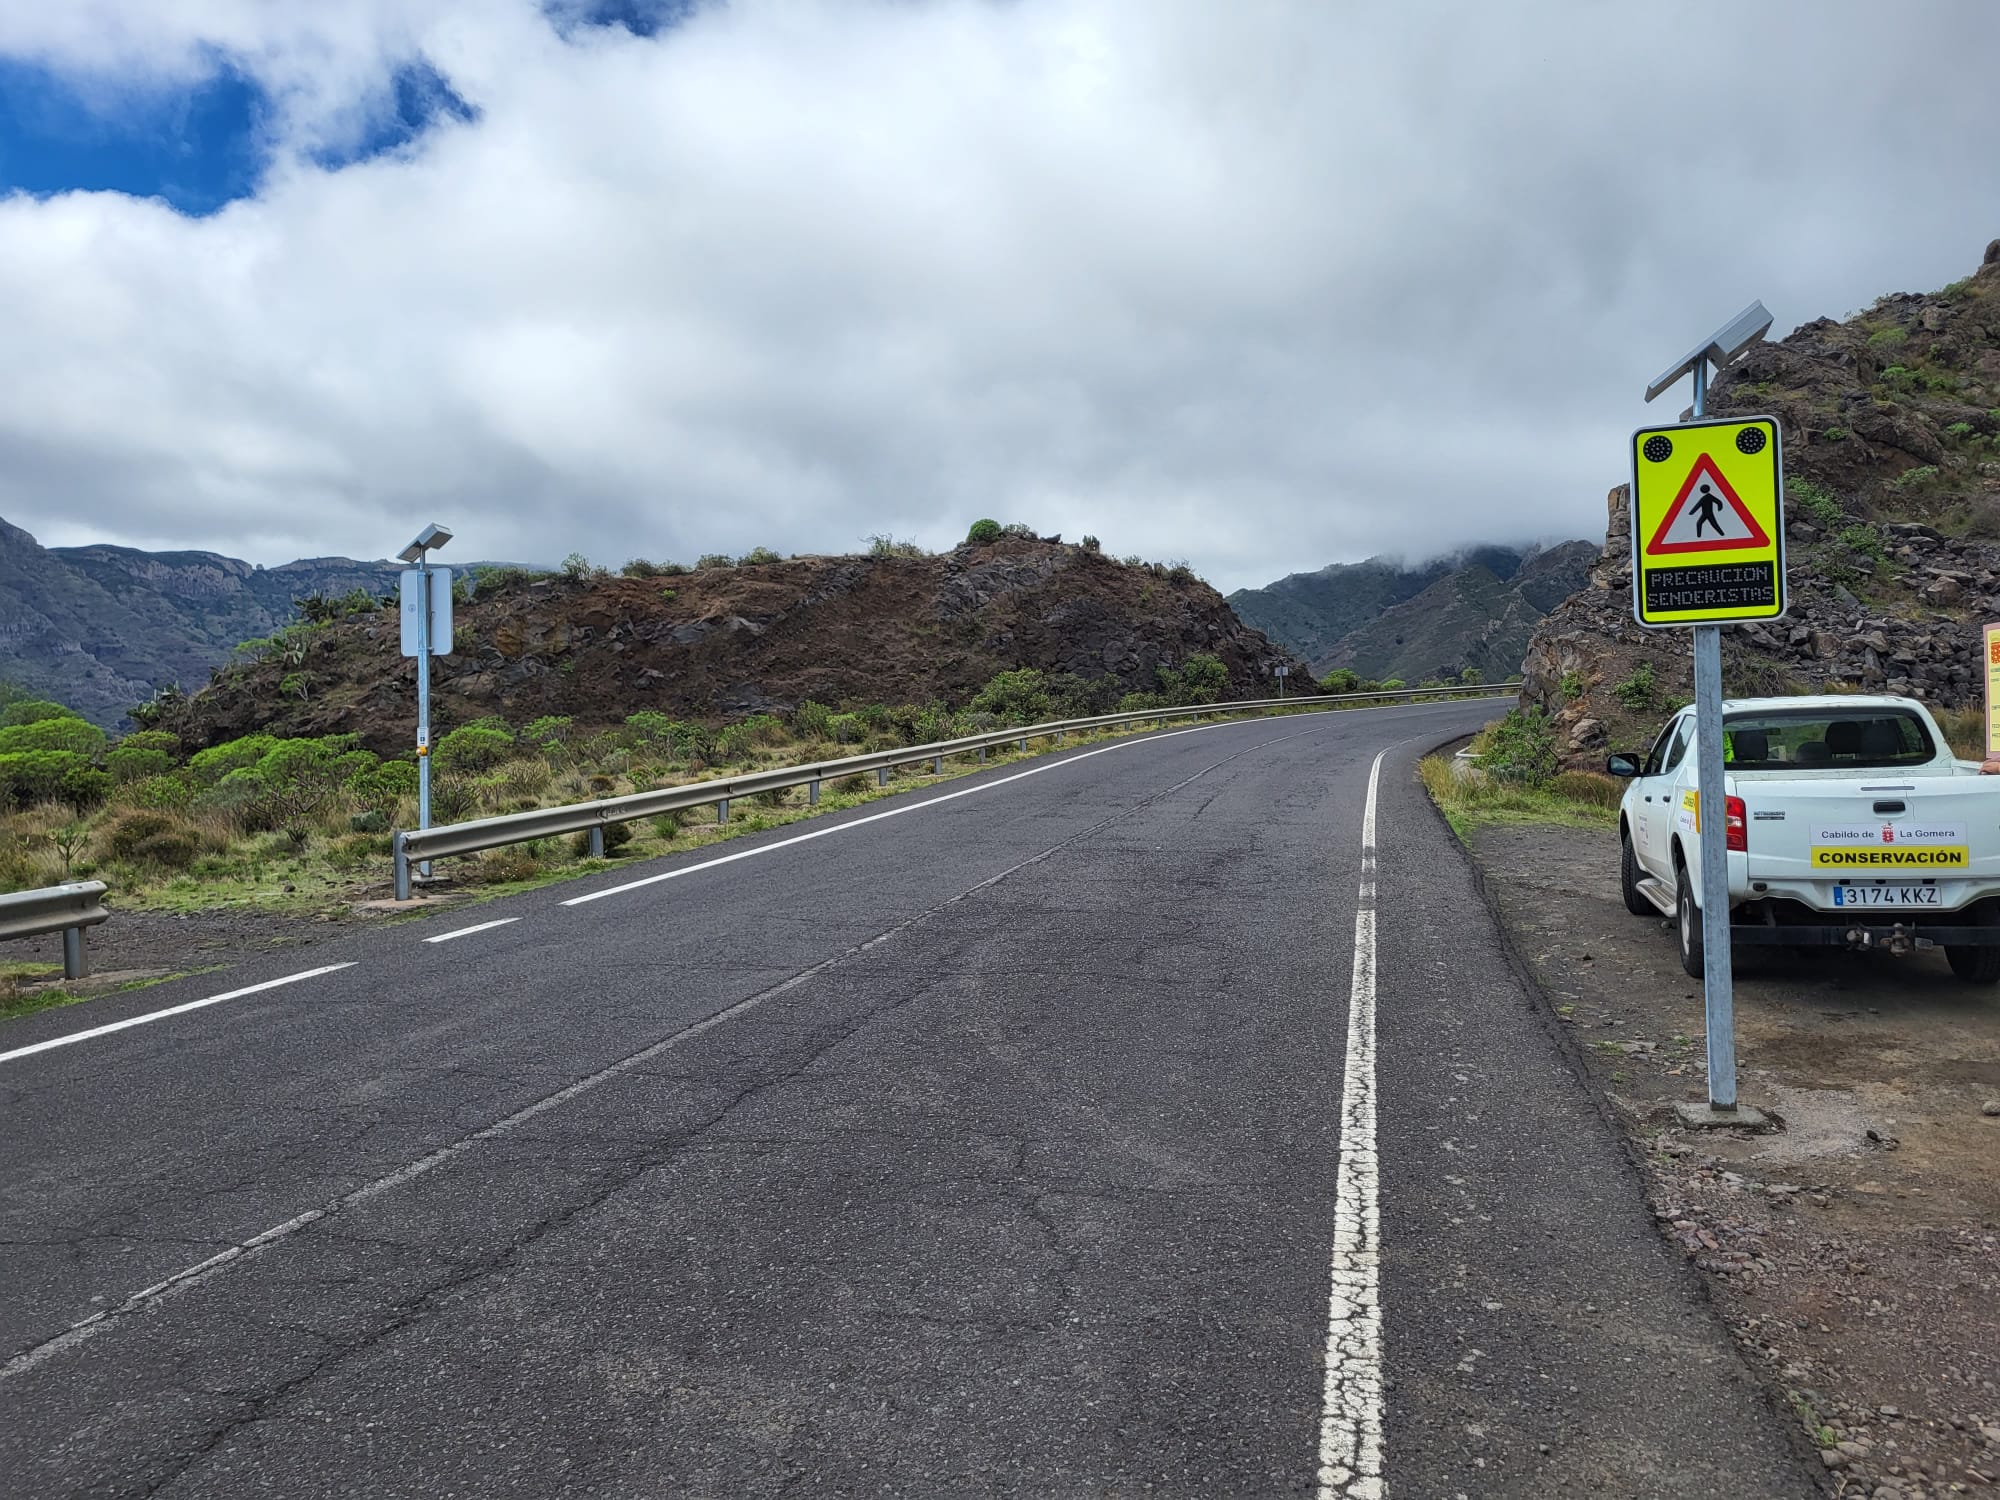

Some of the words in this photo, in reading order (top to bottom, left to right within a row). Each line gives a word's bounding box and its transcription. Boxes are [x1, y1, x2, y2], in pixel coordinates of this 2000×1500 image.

[1651, 566, 1768, 587] PRECAUCION
[1648, 586, 1774, 607] SENDERISTAS
[1821, 830, 1859, 839] Cabildo
[1861, 830, 1875, 838] de
[1900, 830, 1912, 838] La
[1915, 829, 1955, 838] Gomera
[1819, 850, 1961, 864] CONSERVACIÓN
[1846, 888, 1894, 904] 3174
[1900, 888, 1937, 904] KKZ
